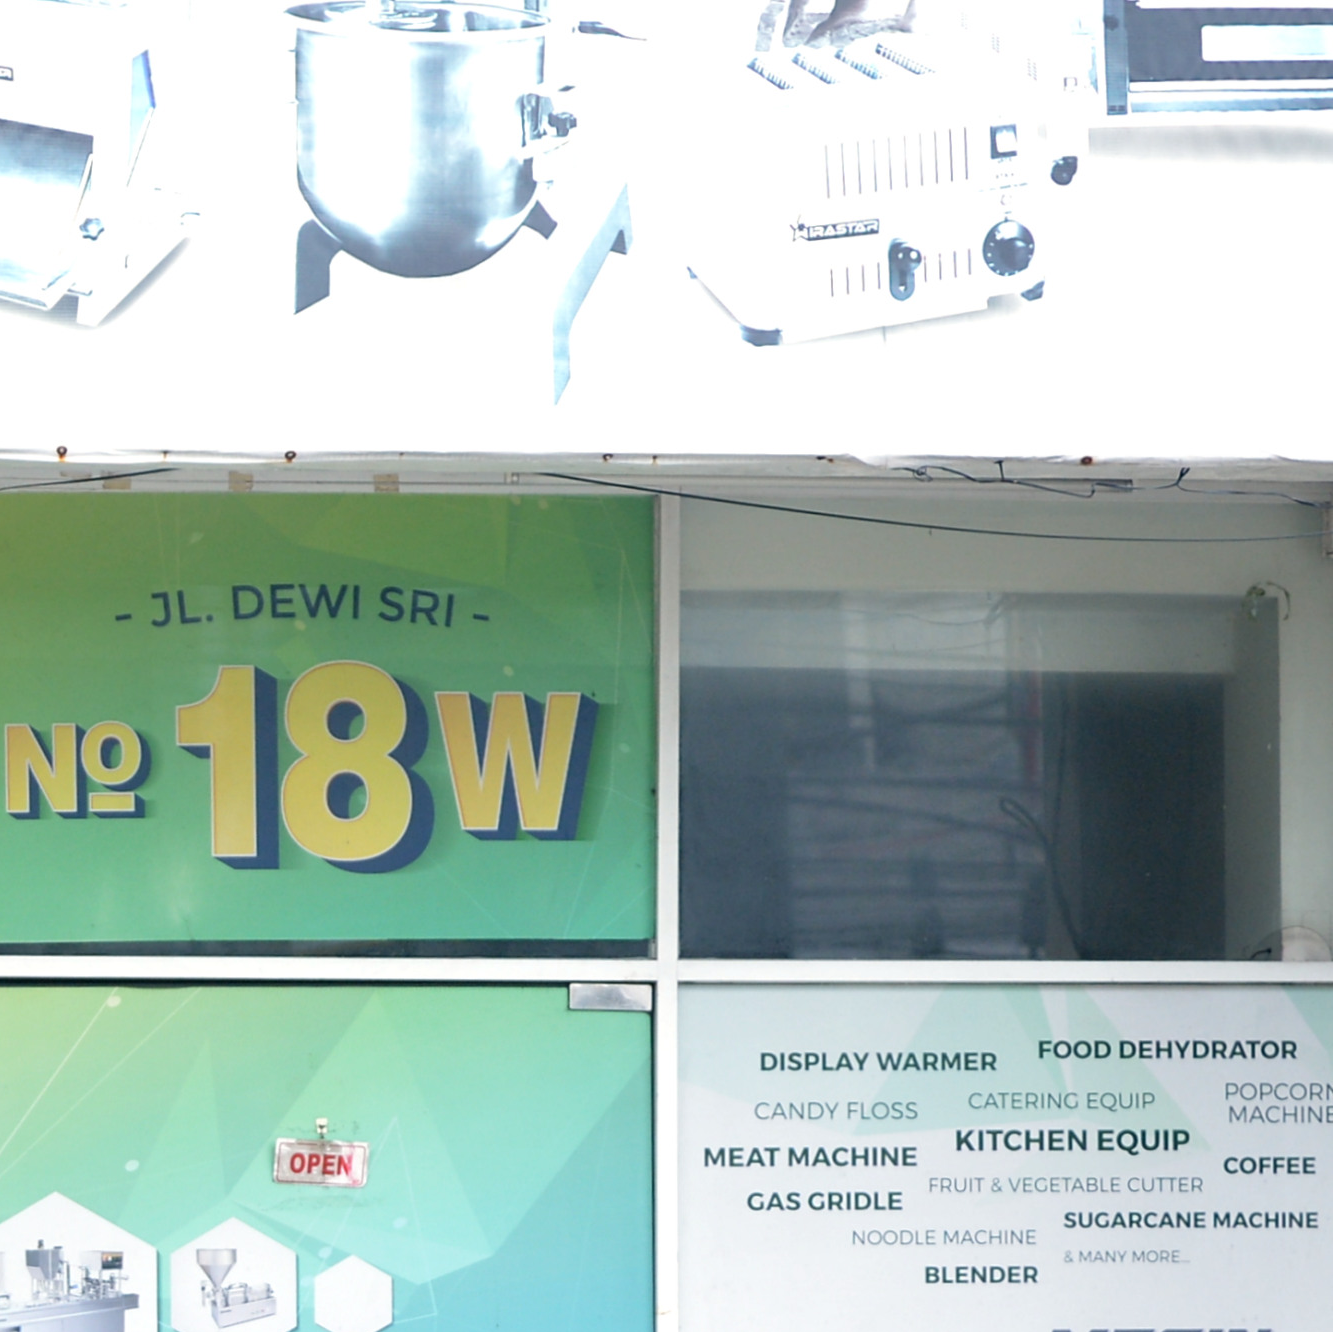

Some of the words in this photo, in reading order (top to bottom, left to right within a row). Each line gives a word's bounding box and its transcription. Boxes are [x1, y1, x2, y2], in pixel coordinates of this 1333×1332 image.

[151, 590, 213, 627] JL.
[232, 584, 360, 620] DEWI
[378, 587, 454, 627] SRI
[1039, 1041, 1111, 1059] FOOD
[1120, 1041, 1297, 1059] DEHYDRATOR
[761, 1053, 868, 1071] DISPLAY
[877, 1053, 996, 1071] WARMER
[754, 1102, 838, 1120] CANDY
[847, 1102, 918, 1120] FLOSS
[968, 1093, 1078, 1109] CATERING
[1087, 1092, 1155, 1112] EQUIP
[956, 1130, 1087, 1151] KITCHEN
[1098, 1130, 1190, 1156] EQUIP
[290, 1152, 353, 1176] OPEN
[705, 1148, 780, 1167] MEAT
[789, 1147, 917, 1166] MACHINE
[1224, 1157, 1315, 1174] COFFEE
[929, 1177, 984, 1193] FRUIT
[991, 1178, 1002, 1193] &
[1008, 1177, 1120, 1193] VEGETABLE
[1127, 1177, 1203, 1192] CUTTER
[747, 1192, 800, 1211] GAS
[808, 1192, 902, 1210] GRIDLE
[1064, 1212, 1205, 1228] SUGARCANE
[1214, 1212, 1318, 1228] MACHINE
[852, 1230, 935, 1245] NOODLE
[944, 1229, 1036, 1245] MACHINE
[1064, 1250, 1074, 1263] &
[1079, 1251, 1126, 1262] MANY
[925, 1266, 1037, 1283] BLENDER
